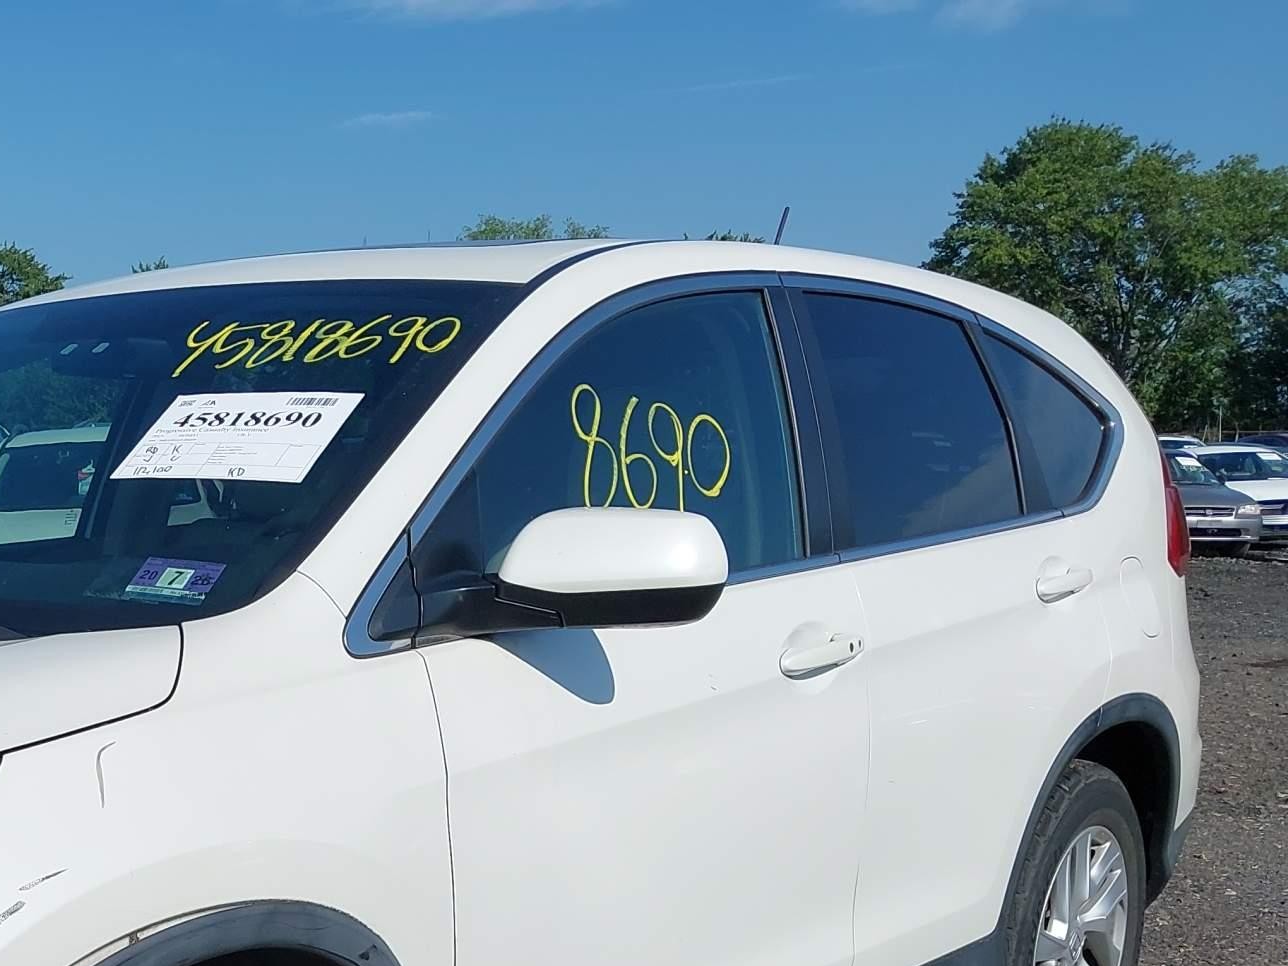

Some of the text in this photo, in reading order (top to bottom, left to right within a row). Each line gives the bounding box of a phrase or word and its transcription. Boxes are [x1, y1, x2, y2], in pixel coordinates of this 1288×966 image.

[171, 314, 461, 378] 45818690
[173, 411, 323, 428] 45818690
[571, 383, 730, 512] 8690
[167, 570, 185, 586] 7
